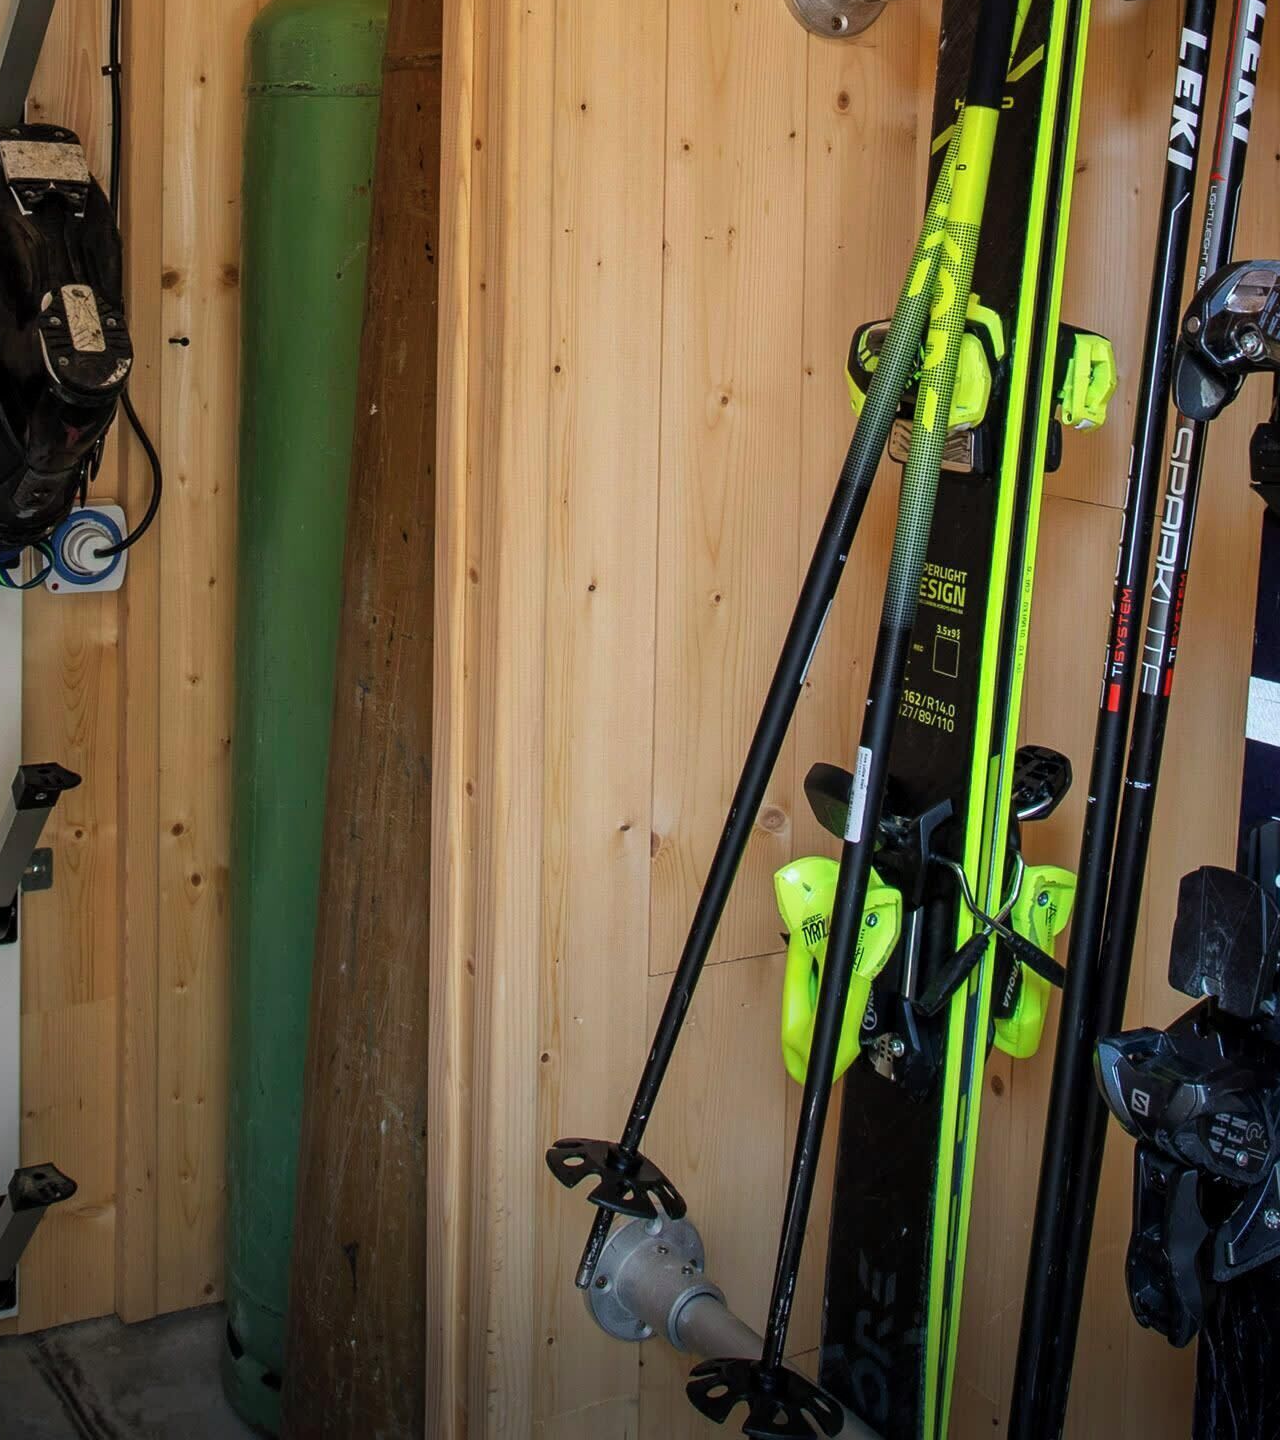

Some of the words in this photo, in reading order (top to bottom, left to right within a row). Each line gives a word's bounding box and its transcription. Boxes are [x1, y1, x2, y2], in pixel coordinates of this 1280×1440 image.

[1167, 27, 1208, 171] LEKI
[1153, 428, 1194, 597] SPARK
[920, 578, 966, 607] ESIGN
[923, 563, 967, 584] PERLIGHT
[1003, 955, 1020, 1008] YROLIA
